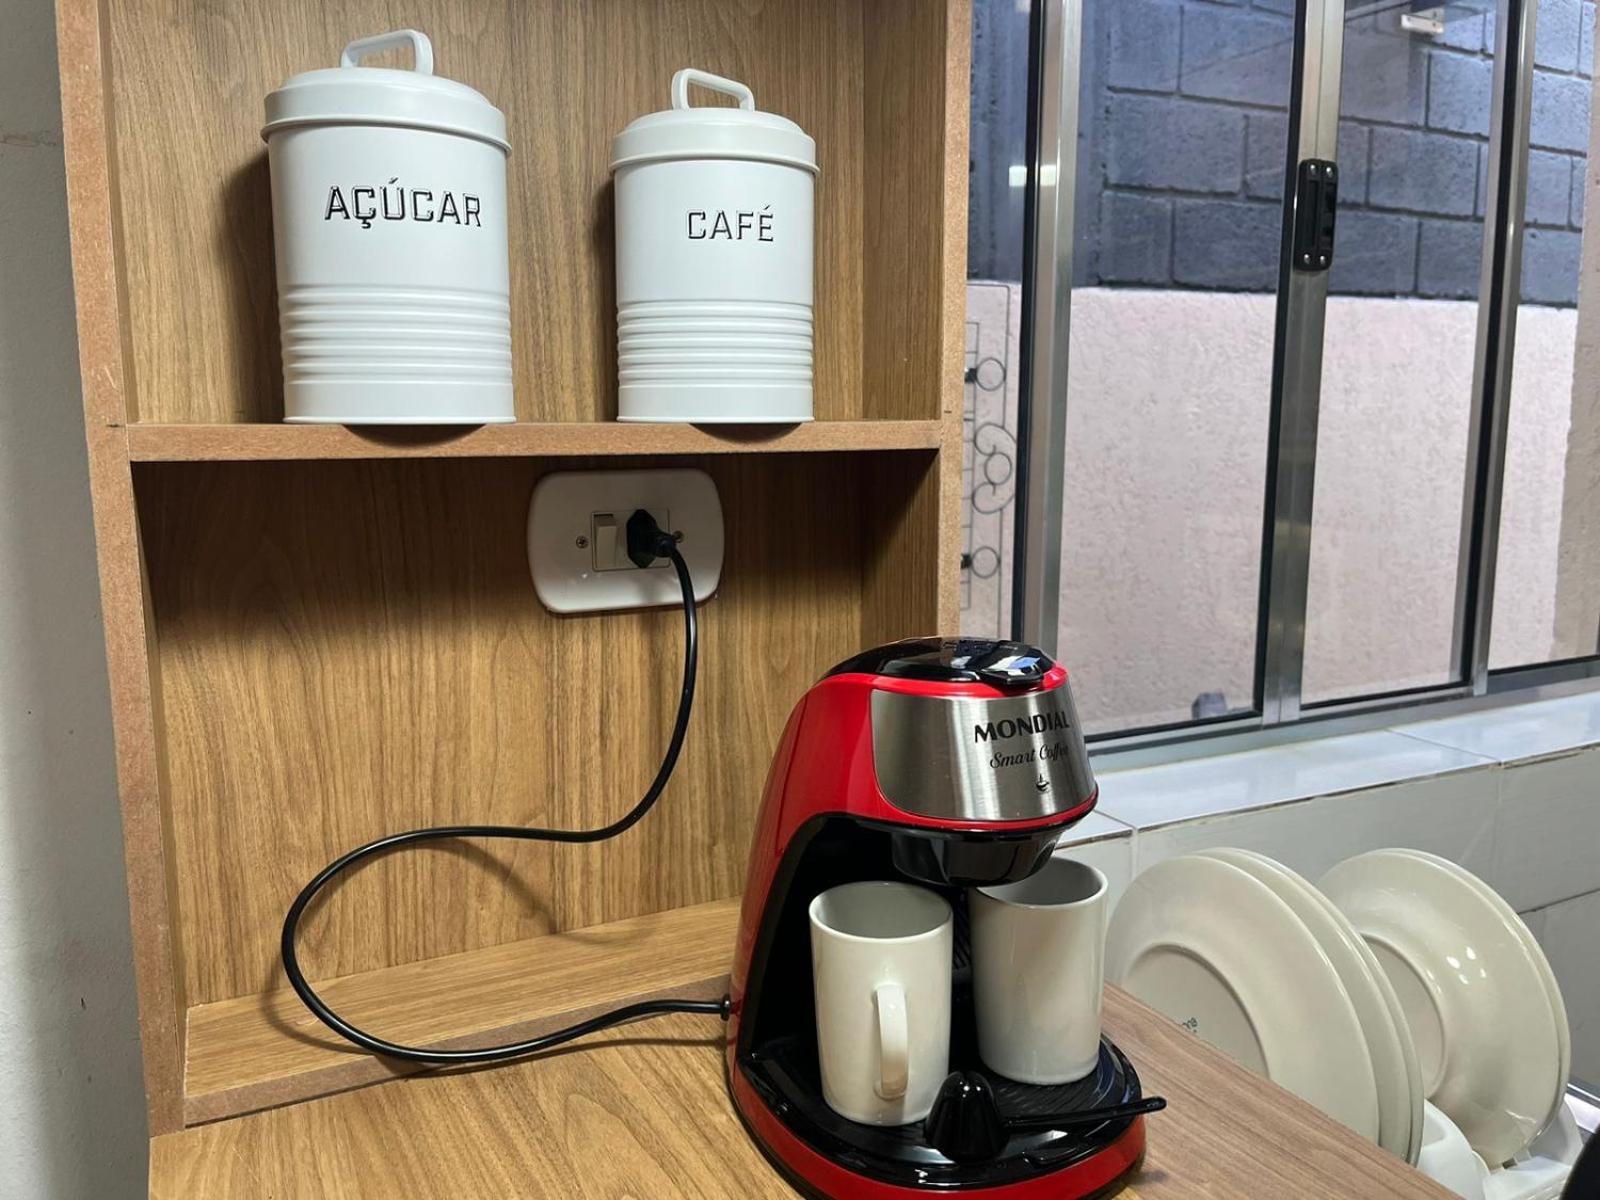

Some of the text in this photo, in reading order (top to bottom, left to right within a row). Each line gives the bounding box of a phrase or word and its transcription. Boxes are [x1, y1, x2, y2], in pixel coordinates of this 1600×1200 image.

[324, 177, 482, 230] AÇÚCAR
[687, 204, 775, 242] CAFÉ
[974, 711, 1070, 743] MONDIAL
[989, 749, 1036, 769] Smart
